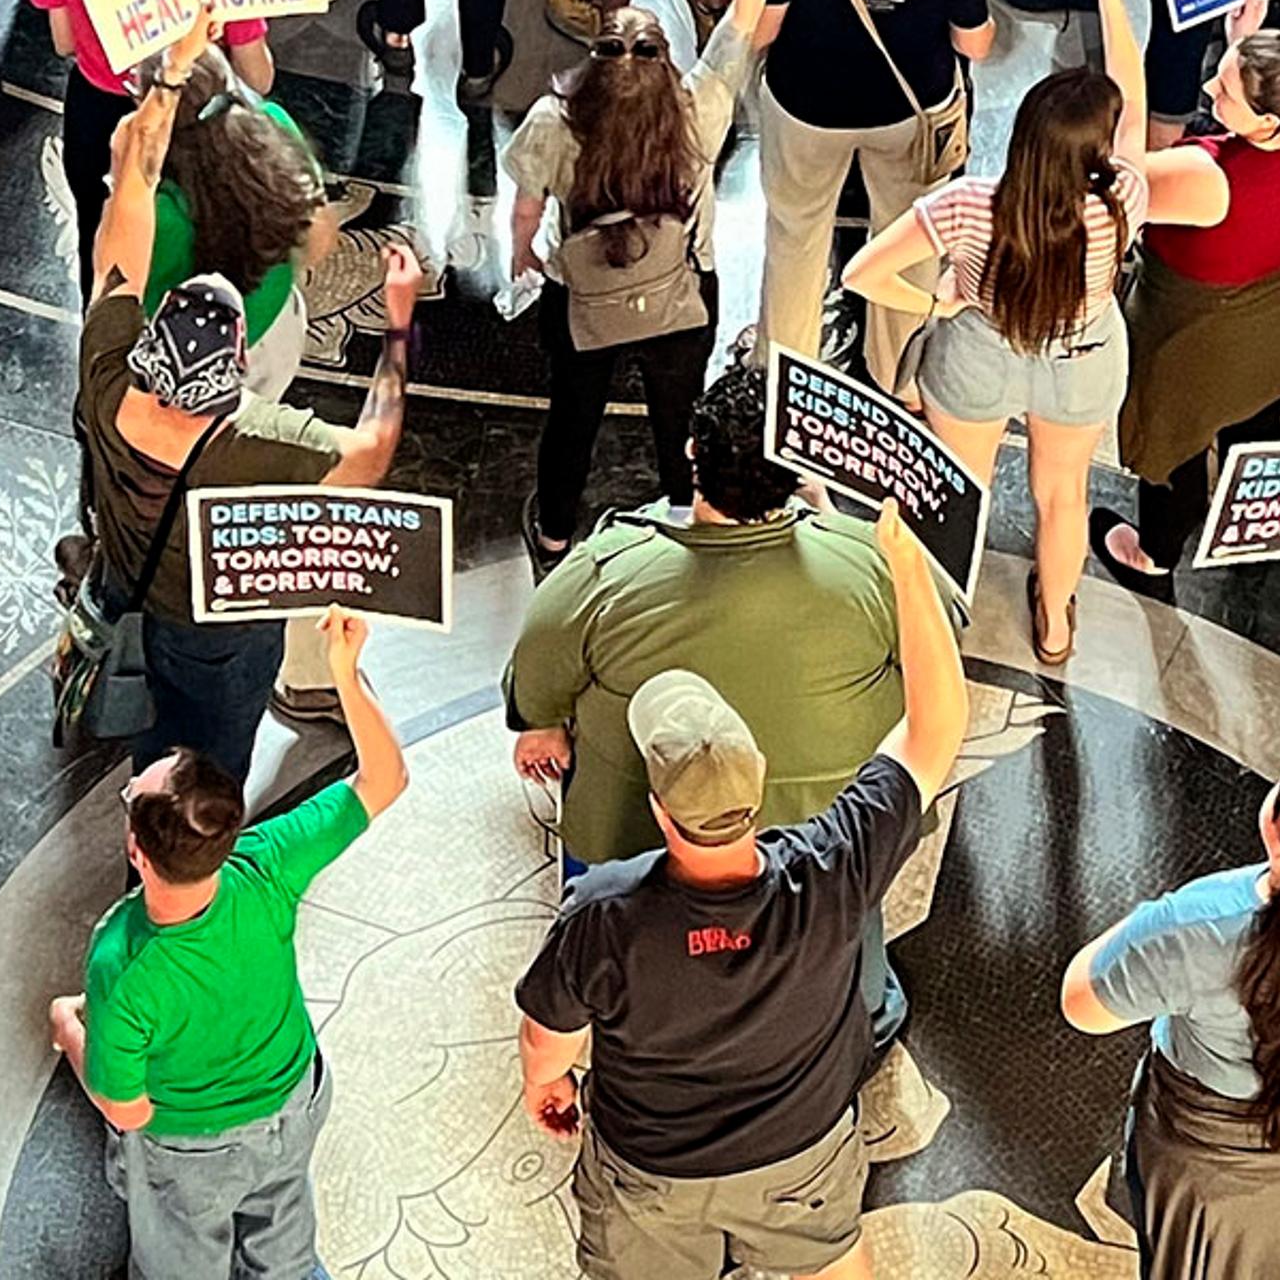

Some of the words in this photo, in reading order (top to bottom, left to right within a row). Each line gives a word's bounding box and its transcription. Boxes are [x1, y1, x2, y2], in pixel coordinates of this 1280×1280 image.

[787, 385, 860, 435] KIDS:
[863, 420, 948, 496] TODAY,
[788, 365, 887, 430] DEFEND
[893, 415, 966, 495] TRANS
[786, 408, 947, 524] TOMORROW,
[786, 430, 805, 451] &
[807, 439, 926, 522] FOREVER.
[210, 501, 321, 525] DEFEND
[324, 502, 420, 532] TRANS
[211, 526, 286, 547] KIDS:
[290, 526, 400, 554] TODAY,
[1220, 522, 1239, 543] &
[211, 548, 401, 579] TOMORROW,
[214, 572, 235, 595] &
[239, 570, 373, 596] FOREVER.
